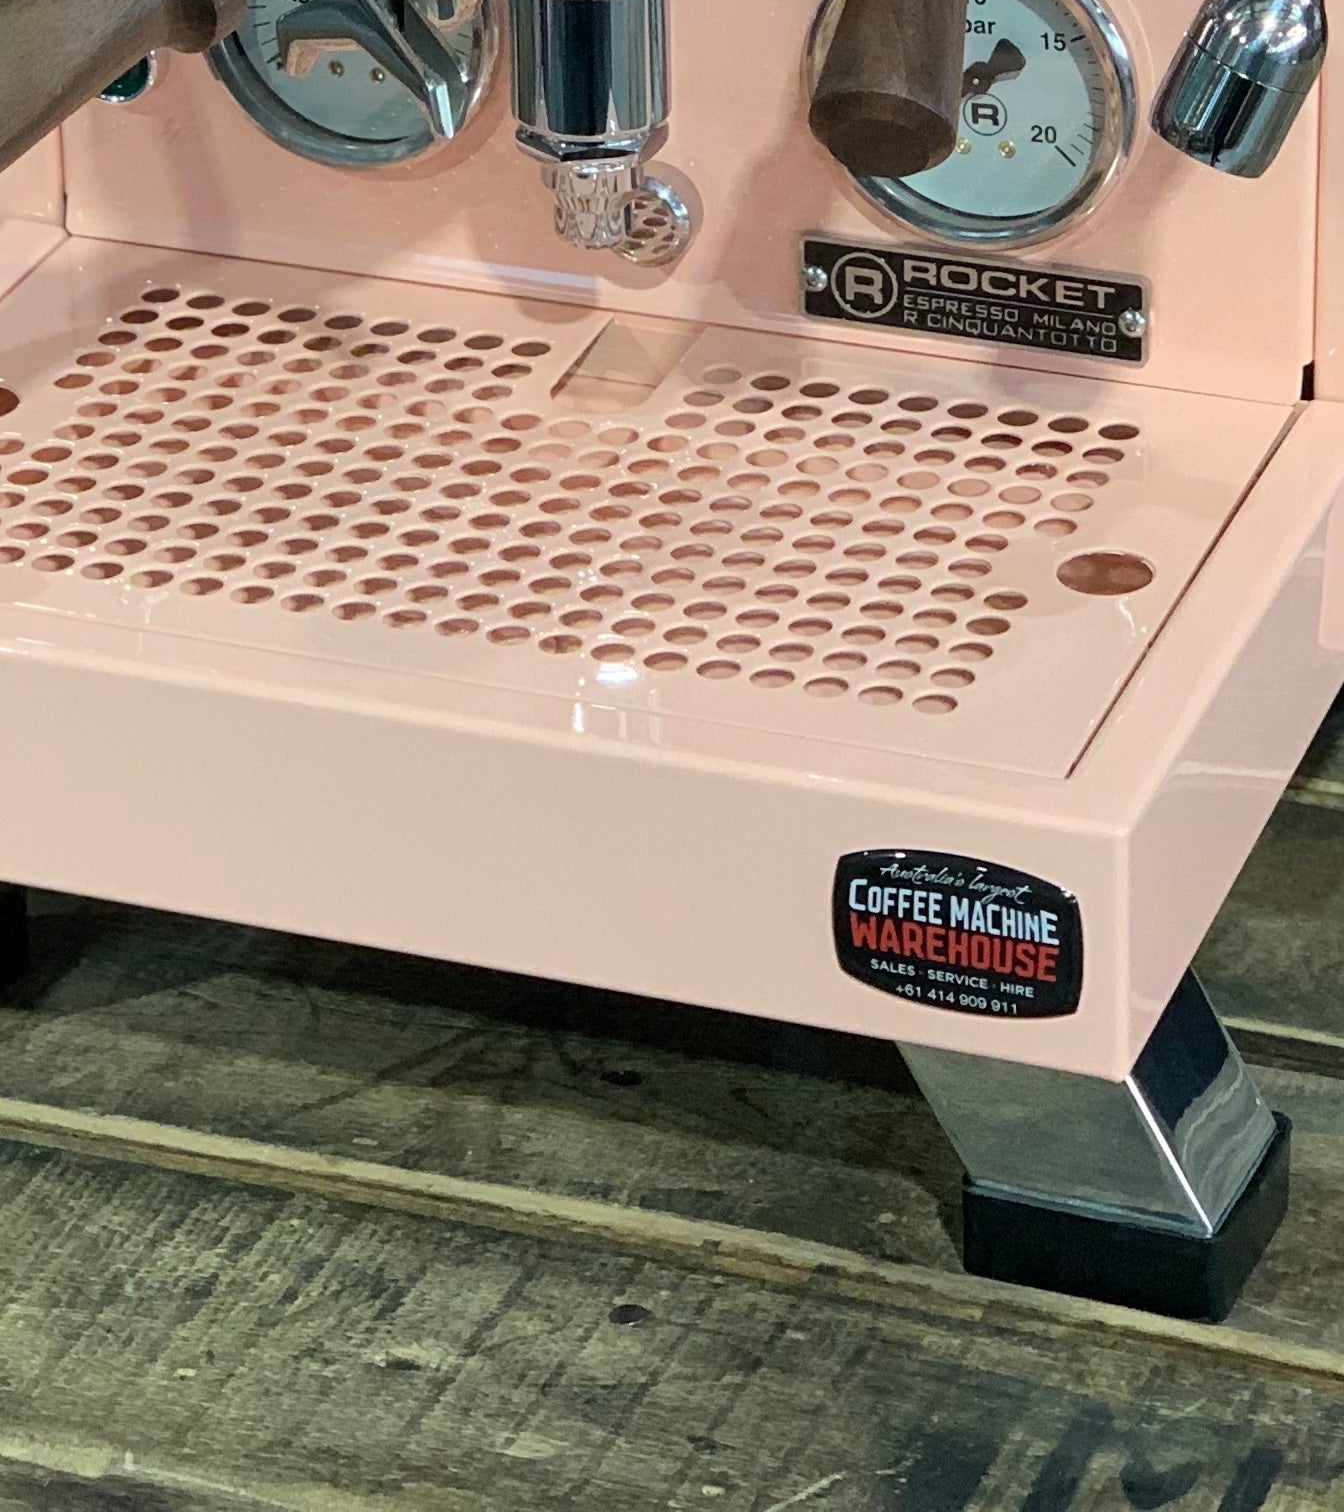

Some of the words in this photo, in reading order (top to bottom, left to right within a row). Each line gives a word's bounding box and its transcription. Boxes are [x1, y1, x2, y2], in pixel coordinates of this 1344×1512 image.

[1040, 32, 1067, 52] 15
[971, 102, 1000, 127] R
[1030, 125, 1057, 144] 20
[844, 265, 884, 305] R
[903, 259, 1116, 309] ROCKET
[903, 294, 1019, 322] ESPRESSO
[1033, 312, 1116, 336] MILANO
[903, 309, 917, 324] R
[927, 313, 1116, 353] CINQUANTOTTO
[879, 863, 965, 887] Australia's
[848, 878, 943, 926] COFFEE
[949, 895, 1060, 946] MACHINE
[849, 909, 1061, 983] WAREHOUSE
[870, 958, 916, 977] SALES
[927, 969, 989, 990] SERVICE
[1000, 981, 1035, 999] HIRE
[896, 983, 922, 998] +61
[927, 988, 956, 1004] 414
[959, 993, 988, 1010] 909
[991, 999, 1018, 1015] 911
